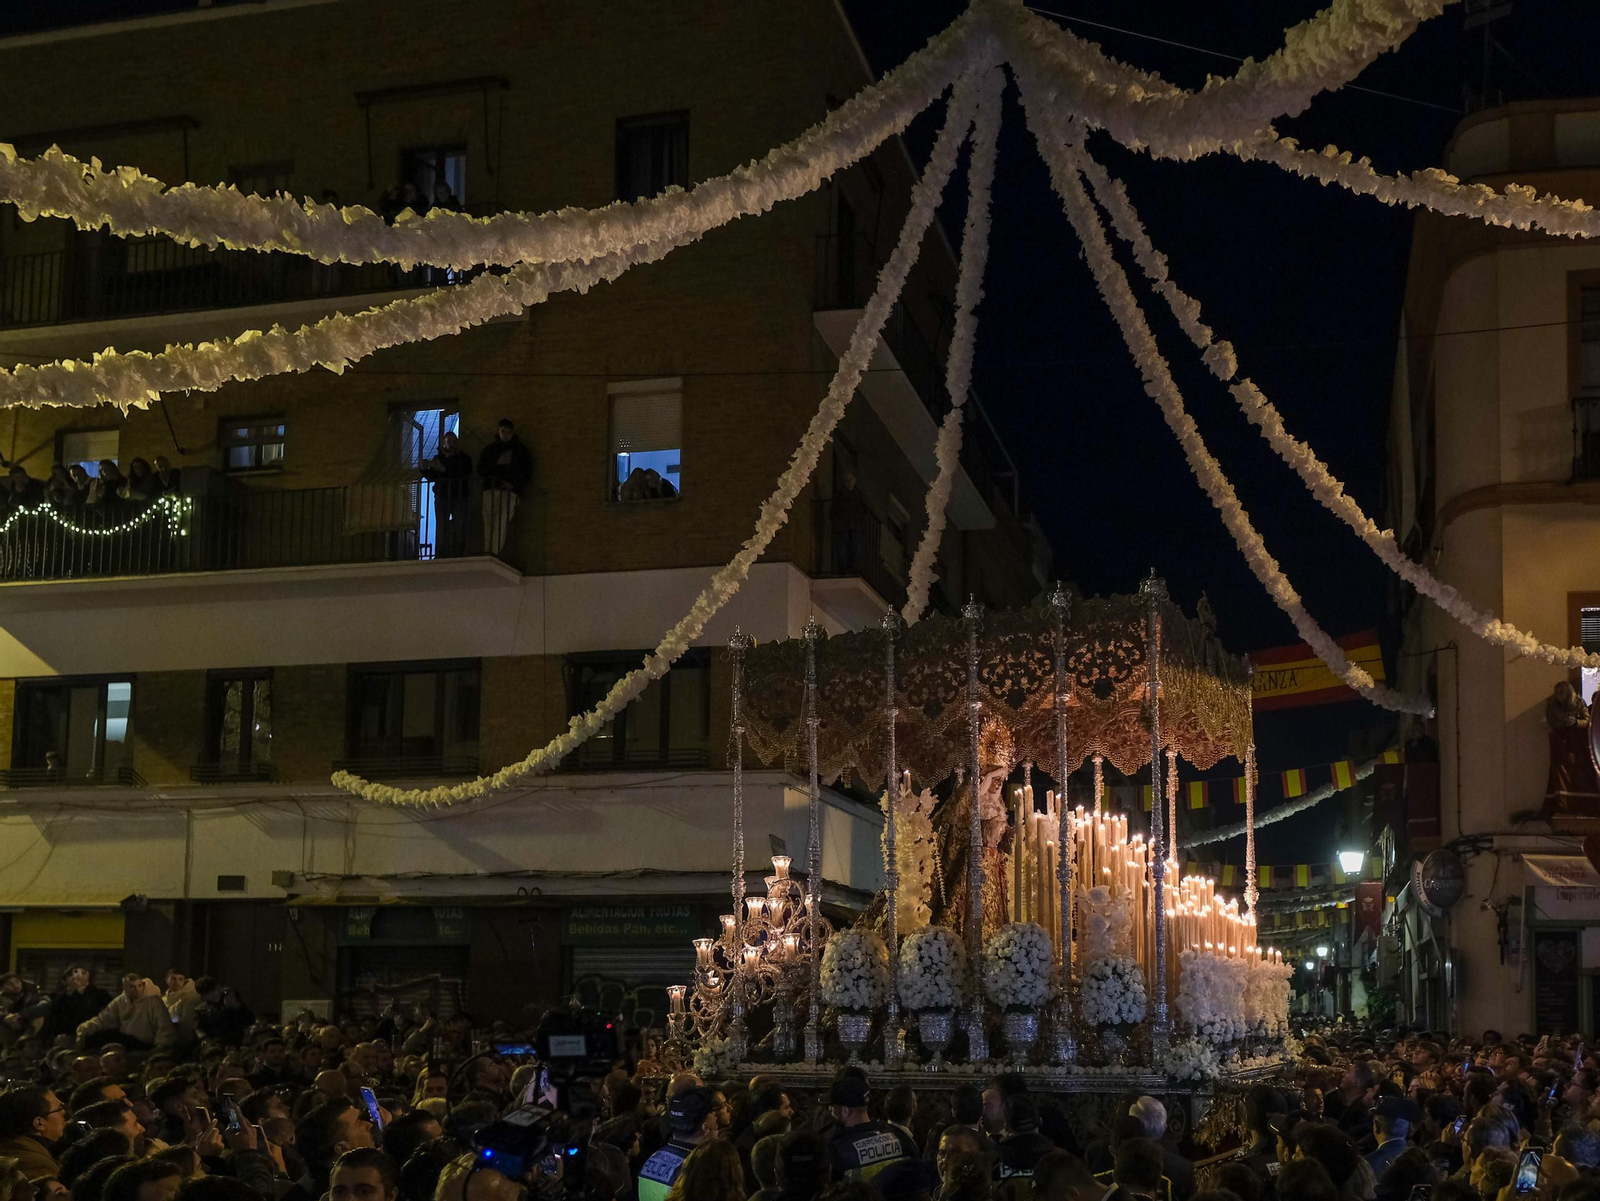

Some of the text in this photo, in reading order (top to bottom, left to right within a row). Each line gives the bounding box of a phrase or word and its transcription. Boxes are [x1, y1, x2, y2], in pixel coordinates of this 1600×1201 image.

[1542, 871, 1586, 879] VICTORIA
[649, 905, 690, 917] FRUTAS
[568, 923, 620, 935] Bebidas
[623, 923, 651, 936] Pan,
[859, 1141, 901, 1161] POLICIA
